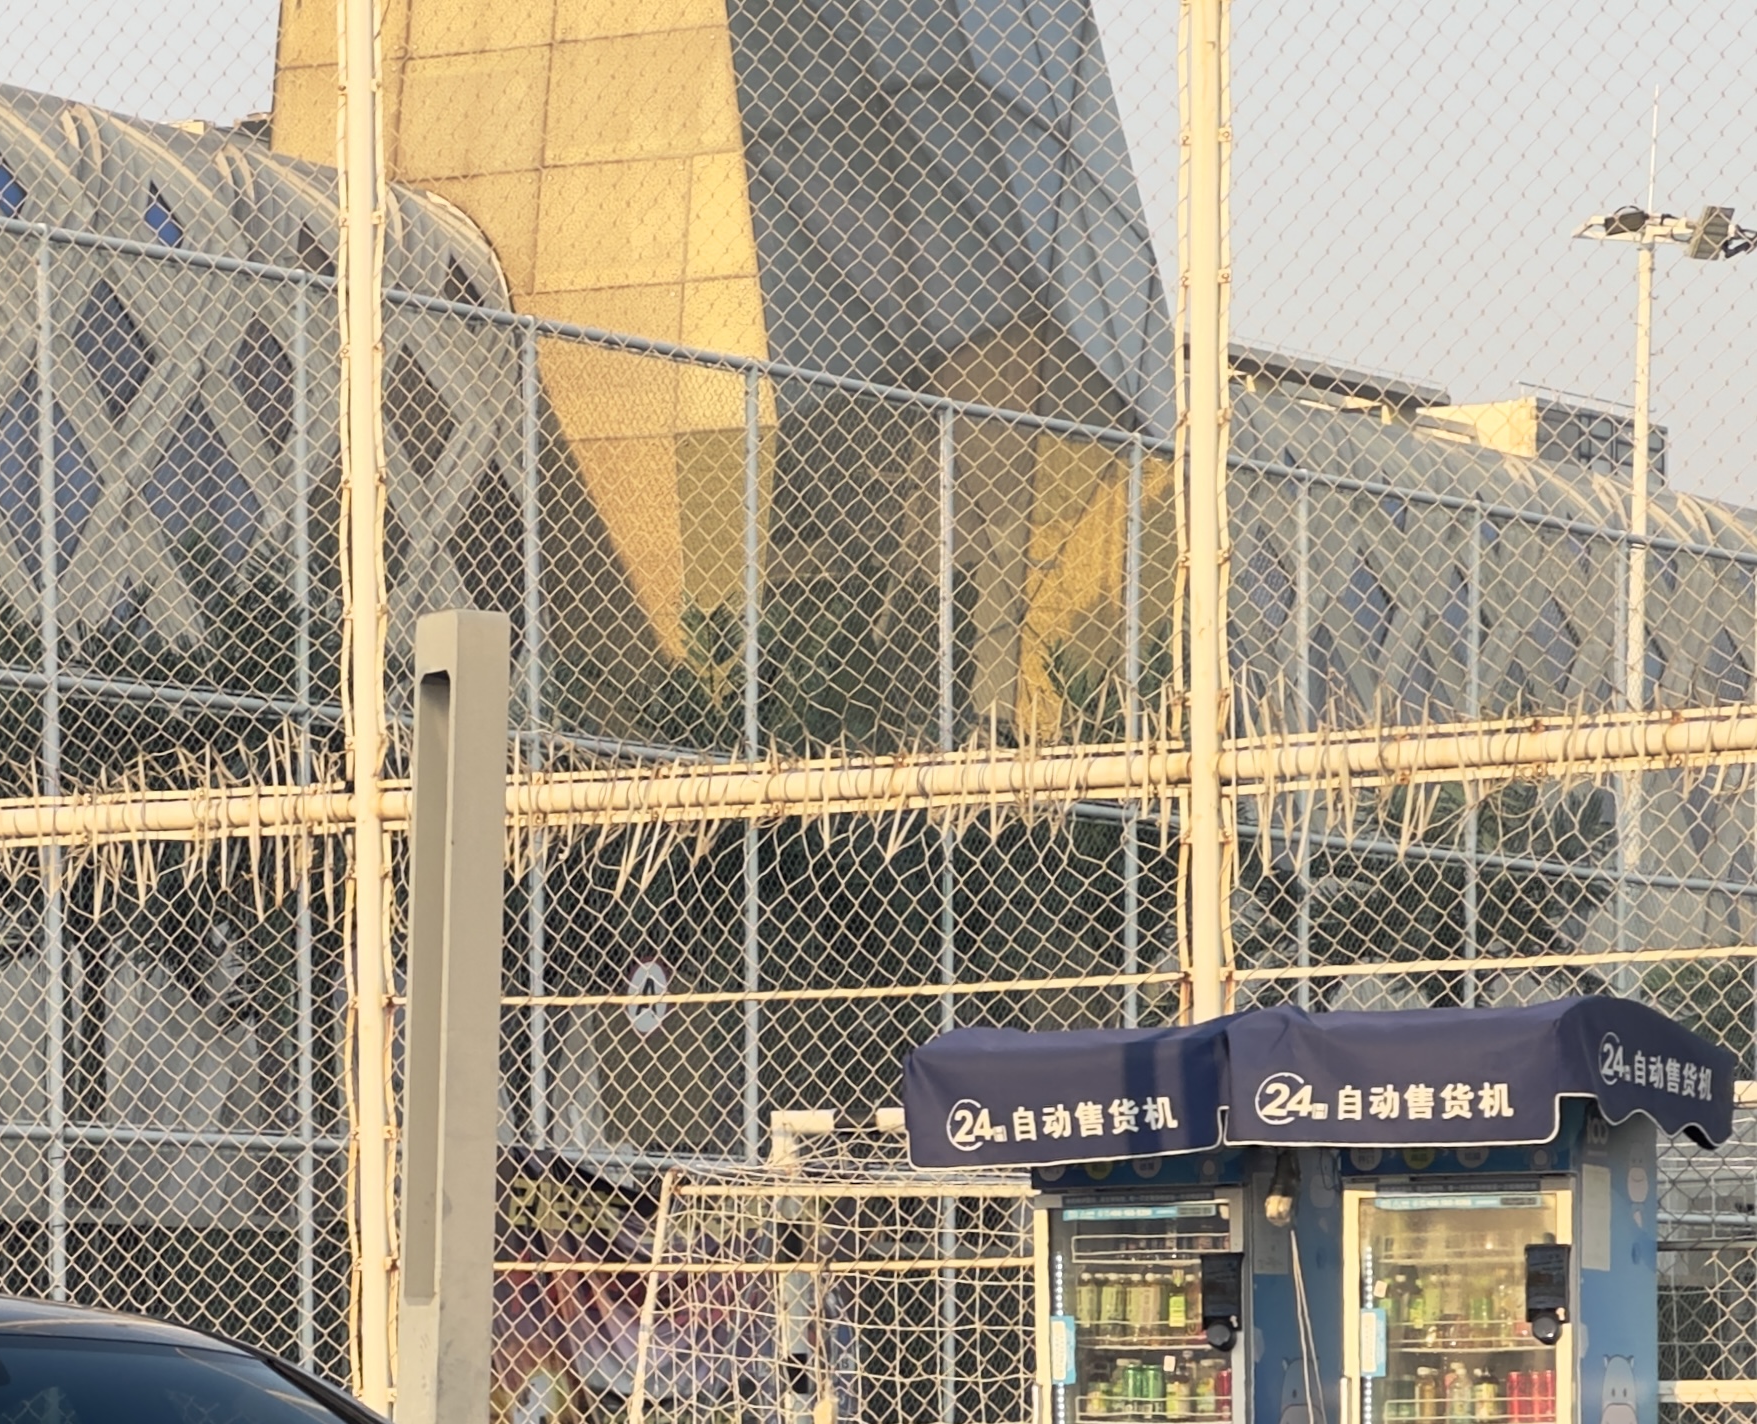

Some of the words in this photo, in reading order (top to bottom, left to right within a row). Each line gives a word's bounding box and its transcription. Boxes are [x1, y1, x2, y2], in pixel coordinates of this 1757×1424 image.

[1634, 1050, 1712, 1101] 自动售货机
[1012, 1097, 1178, 1142] 自动售货机
[1337, 1082, 1514, 1120] 自动售货机
